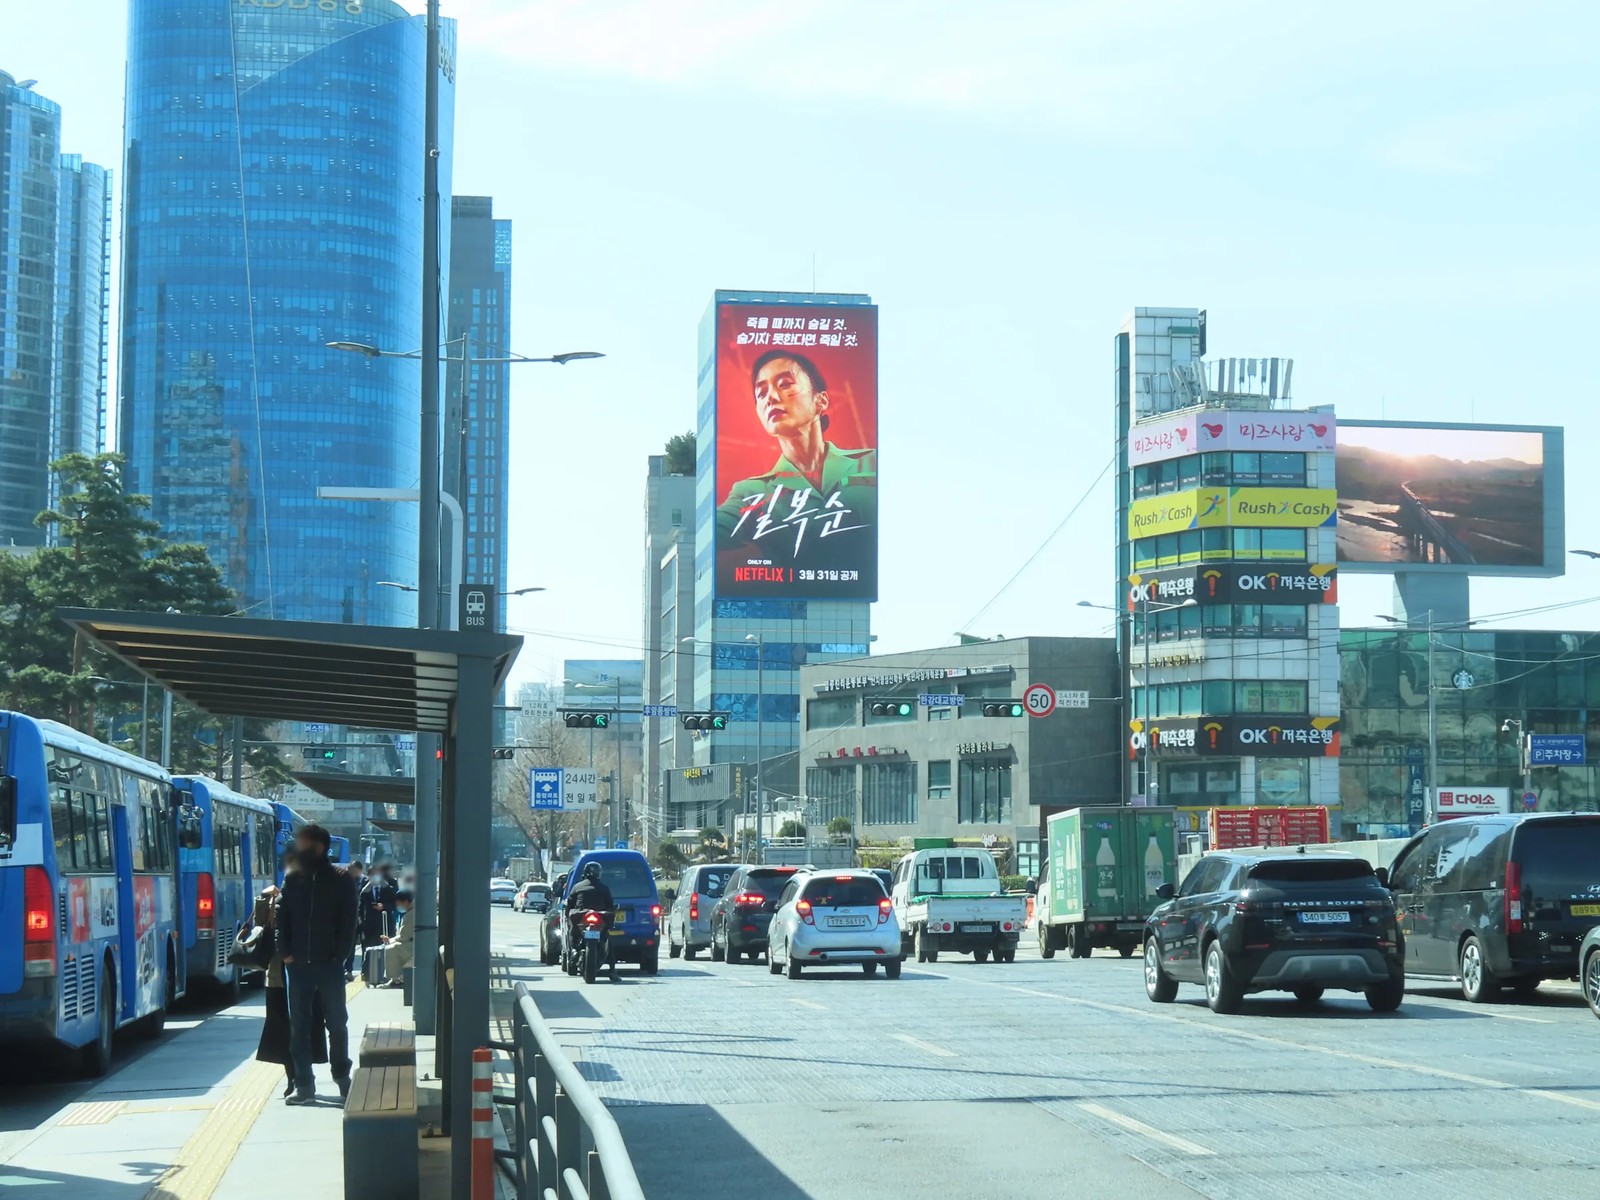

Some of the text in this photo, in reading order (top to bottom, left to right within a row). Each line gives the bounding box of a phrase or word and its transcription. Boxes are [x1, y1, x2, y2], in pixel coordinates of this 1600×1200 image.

[746, 317, 847, 331] 죽을 때까지 숨길 것.
[736, 332, 770, 345] 숨기지
[820, 334, 840, 346] 죽일
[844, 334, 858, 347] 것.
[1239, 423, 1304, 442] 미즈사랑
[1134, 432, 1173, 452] 미즈사랑
[1238, 501, 1330, 515] Rush Cash
[730, 484, 870, 558] 길복순
[1134, 504, 1192, 528] Rush Cash
[736, 568, 783, 582] NETFLIX
[799, 570, 858, 581] 3월 31일 공개
[1130, 577, 1194, 602] OK 저축은행
[1238, 575, 1331, 591] OK 저축은행
[466, 616, 485, 626] BUS
[921, 696, 963, 705] 한강대교방면
[1030, 694, 1049, 708] 50
[644, 706, 676, 716] 후암동방면
[1159, 728, 1195, 748] 저축은행
[1240, 728, 1333, 744] OK 저축은행
[1545, 750, 1572, 760] 주차장
[565, 773, 596, 784] 24시간
[566, 793, 596, 803] 전일제
[1456, 794, 1495, 804] 다이소
[1328, 912, 1348, 921] 5057
